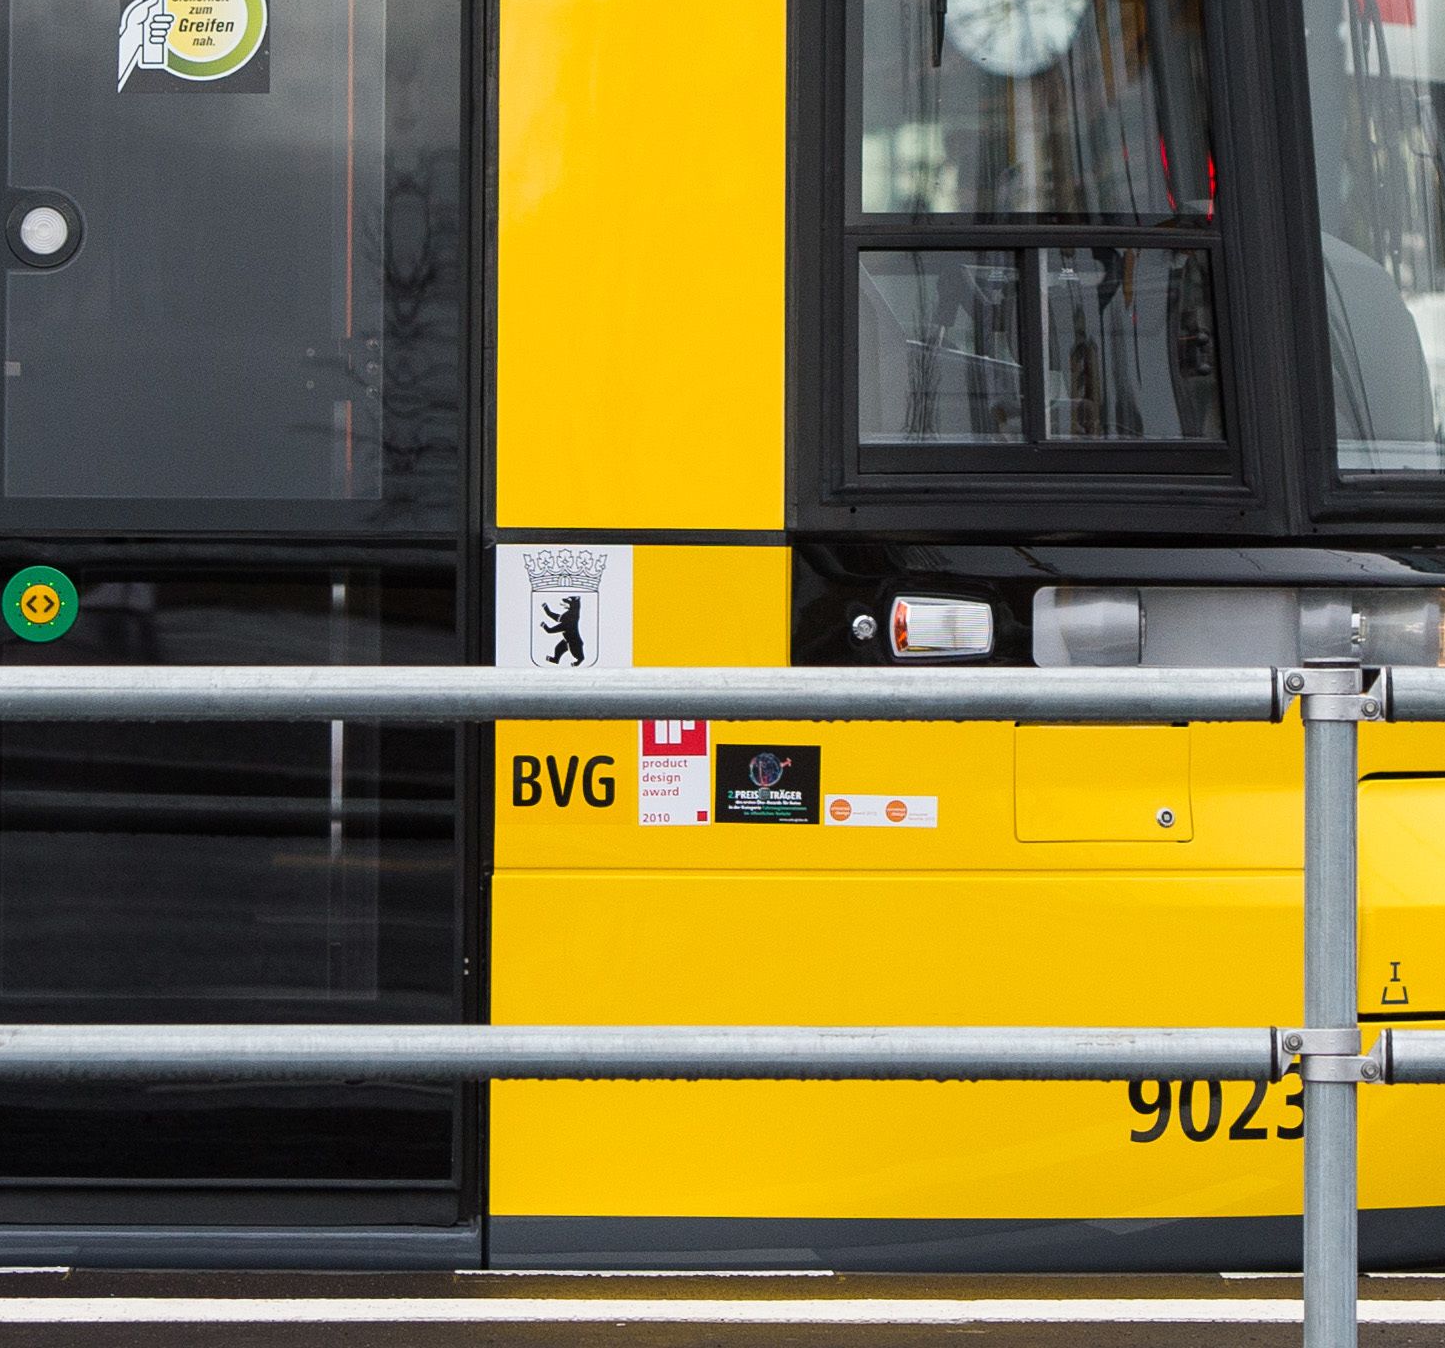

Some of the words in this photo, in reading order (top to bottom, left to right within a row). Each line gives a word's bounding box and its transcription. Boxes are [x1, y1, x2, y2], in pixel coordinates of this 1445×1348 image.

[188, 6, 213, 15] zum
[178, 17, 235, 33] Greifen
[192, 36, 217, 47] nah.
[642, 758, 689, 770] product
[512, 755, 616, 808] BVG
[642, 772, 682, 784] design
[642, 786, 680, 797] award
[735, 790, 760, 800] PREIS
[769, 789, 803, 800] TRÄGER
[642, 813, 671, 824] 2010
[1128, 1063, 1305, 1143] 9023
